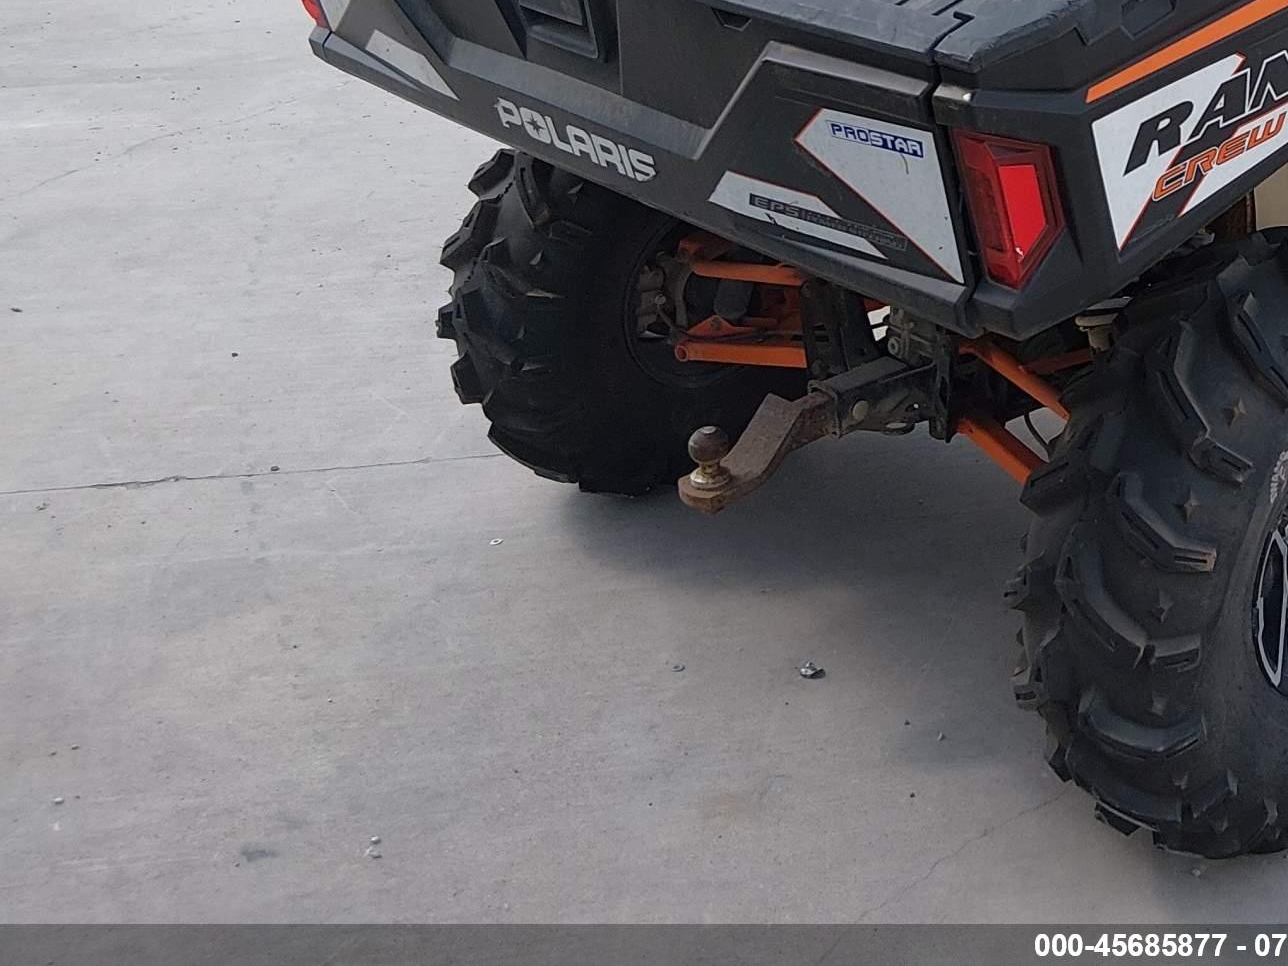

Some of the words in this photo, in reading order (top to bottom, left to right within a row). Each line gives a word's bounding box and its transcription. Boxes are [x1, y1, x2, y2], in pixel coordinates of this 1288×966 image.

[494, 97, 657, 182] POLARIS
[830, 121, 924, 158] PROSTAR
[1151, 111, 1288, 202] CREW
[754, 195, 801, 218] EPS
